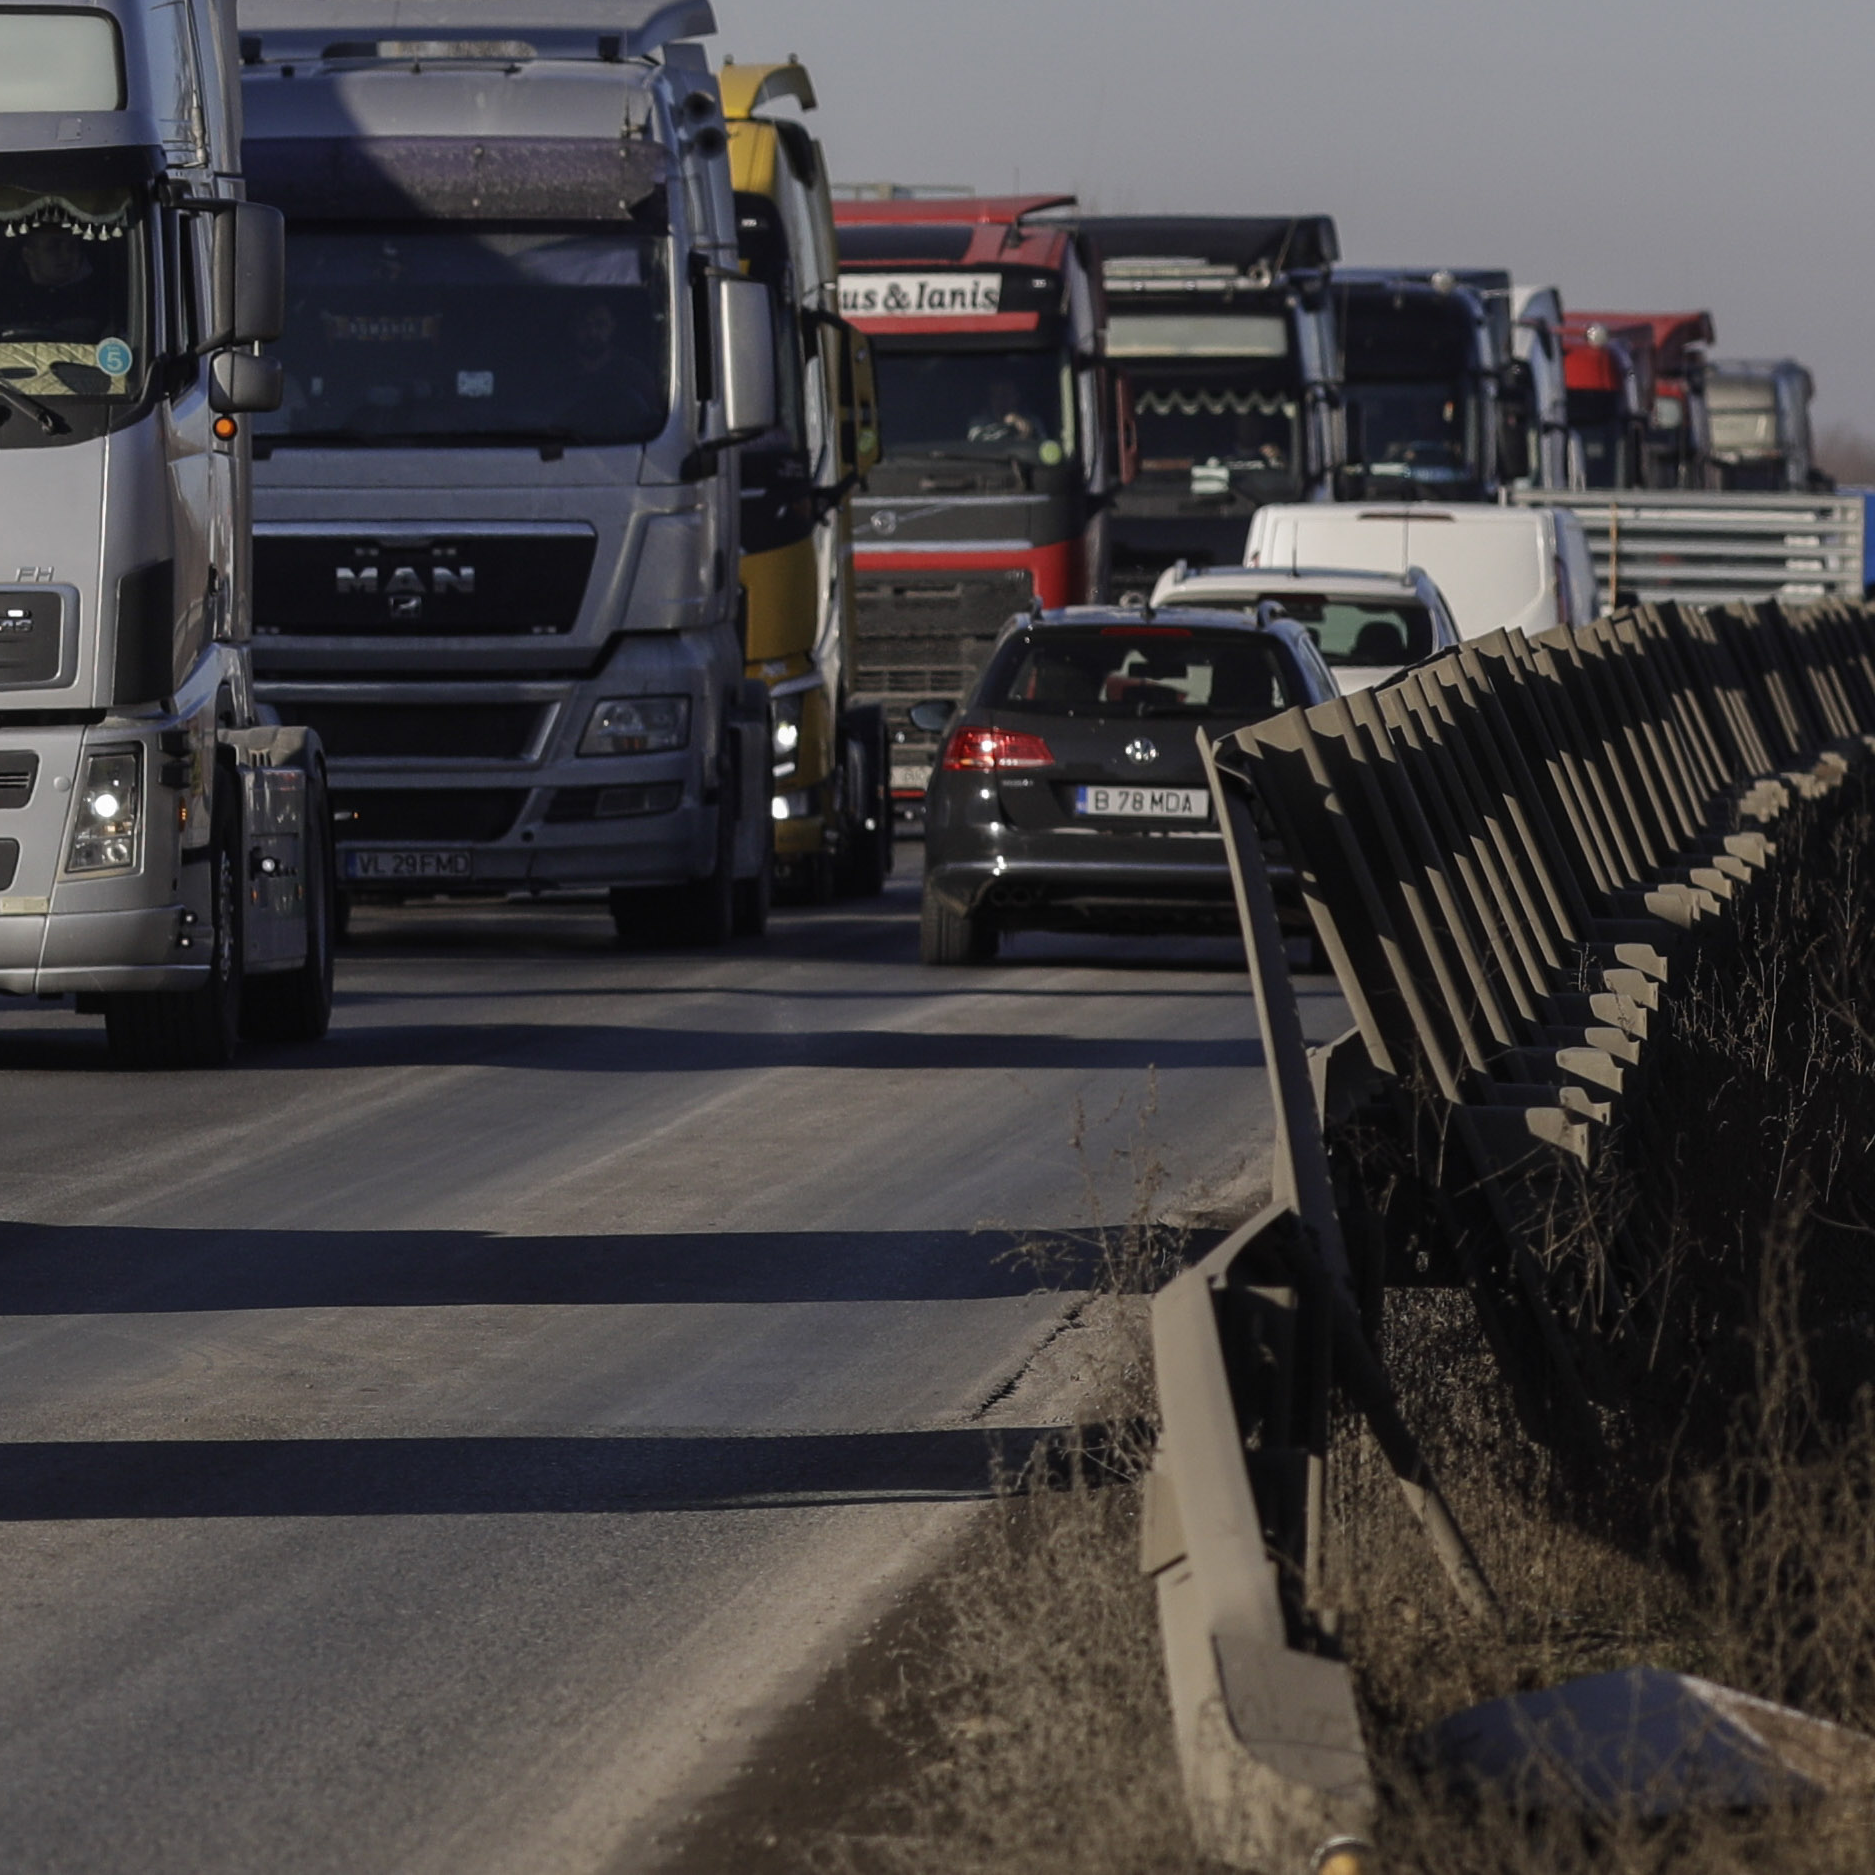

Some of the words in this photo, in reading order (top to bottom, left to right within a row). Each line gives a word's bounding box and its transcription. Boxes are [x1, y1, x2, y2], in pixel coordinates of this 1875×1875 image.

[883, 282, 910, 311] &
[15, 566, 54, 583] FH
[336, 566, 475, 594] MAN
[1094, 790, 1109, 812] B
[1117, 790, 1145, 812] 78
[1151, 793, 1193, 813] MDA
[358, 853, 386, 874] VL
[392, 853, 417, 874] 29
